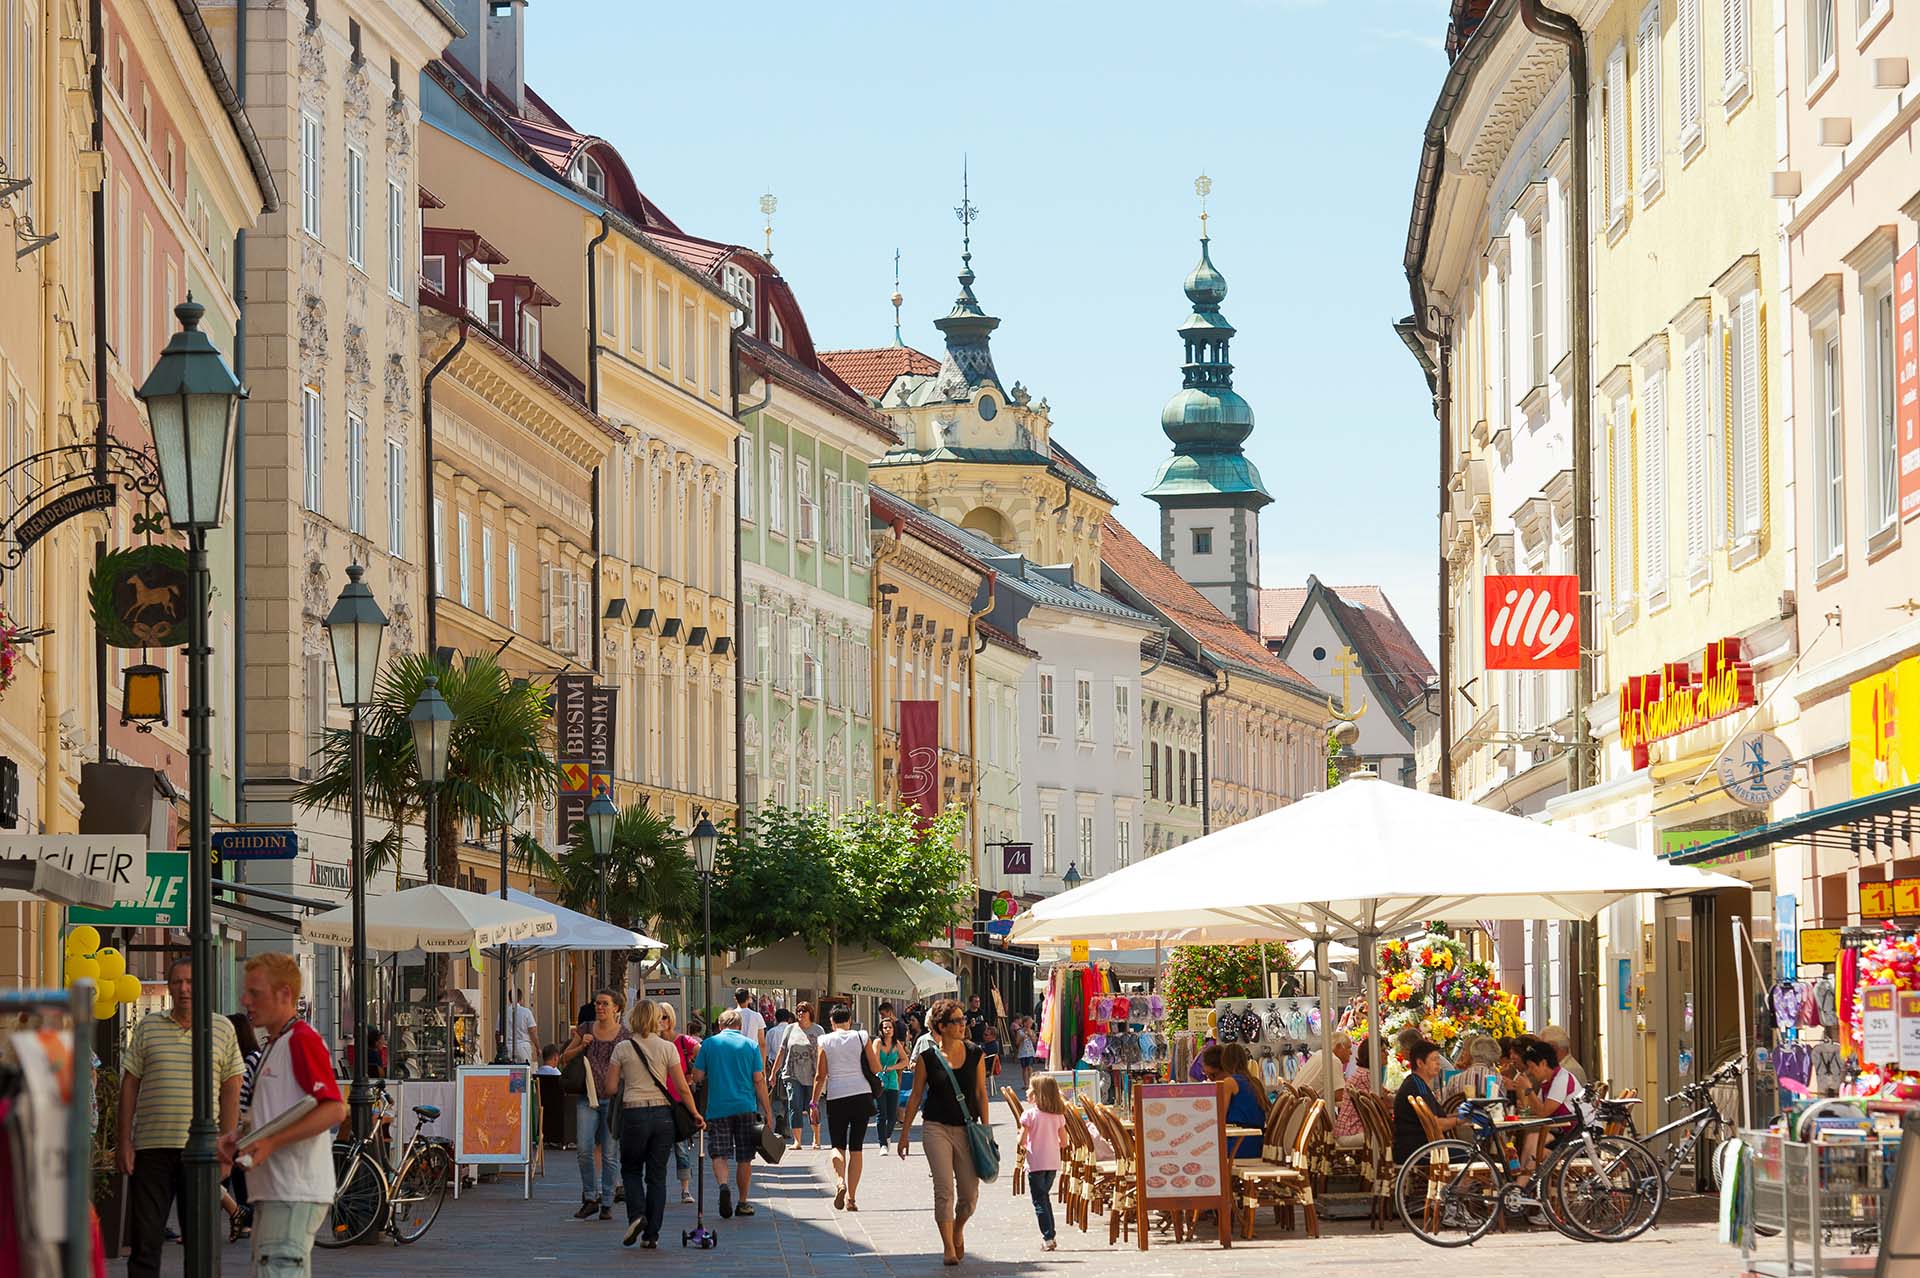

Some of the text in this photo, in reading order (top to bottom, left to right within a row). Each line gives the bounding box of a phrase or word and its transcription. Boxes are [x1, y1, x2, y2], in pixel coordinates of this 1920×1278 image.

[20, 488, 112, 543] FREMDENZIMMER
[1490, 588, 1575, 661] illy
[567, 680, 585, 756] BESIM
[592, 695, 609, 767] BESIM
[902, 746, 937, 798] 3
[223, 836, 287, 849] GHIDINI
[1007, 850, 1026, 869] M
